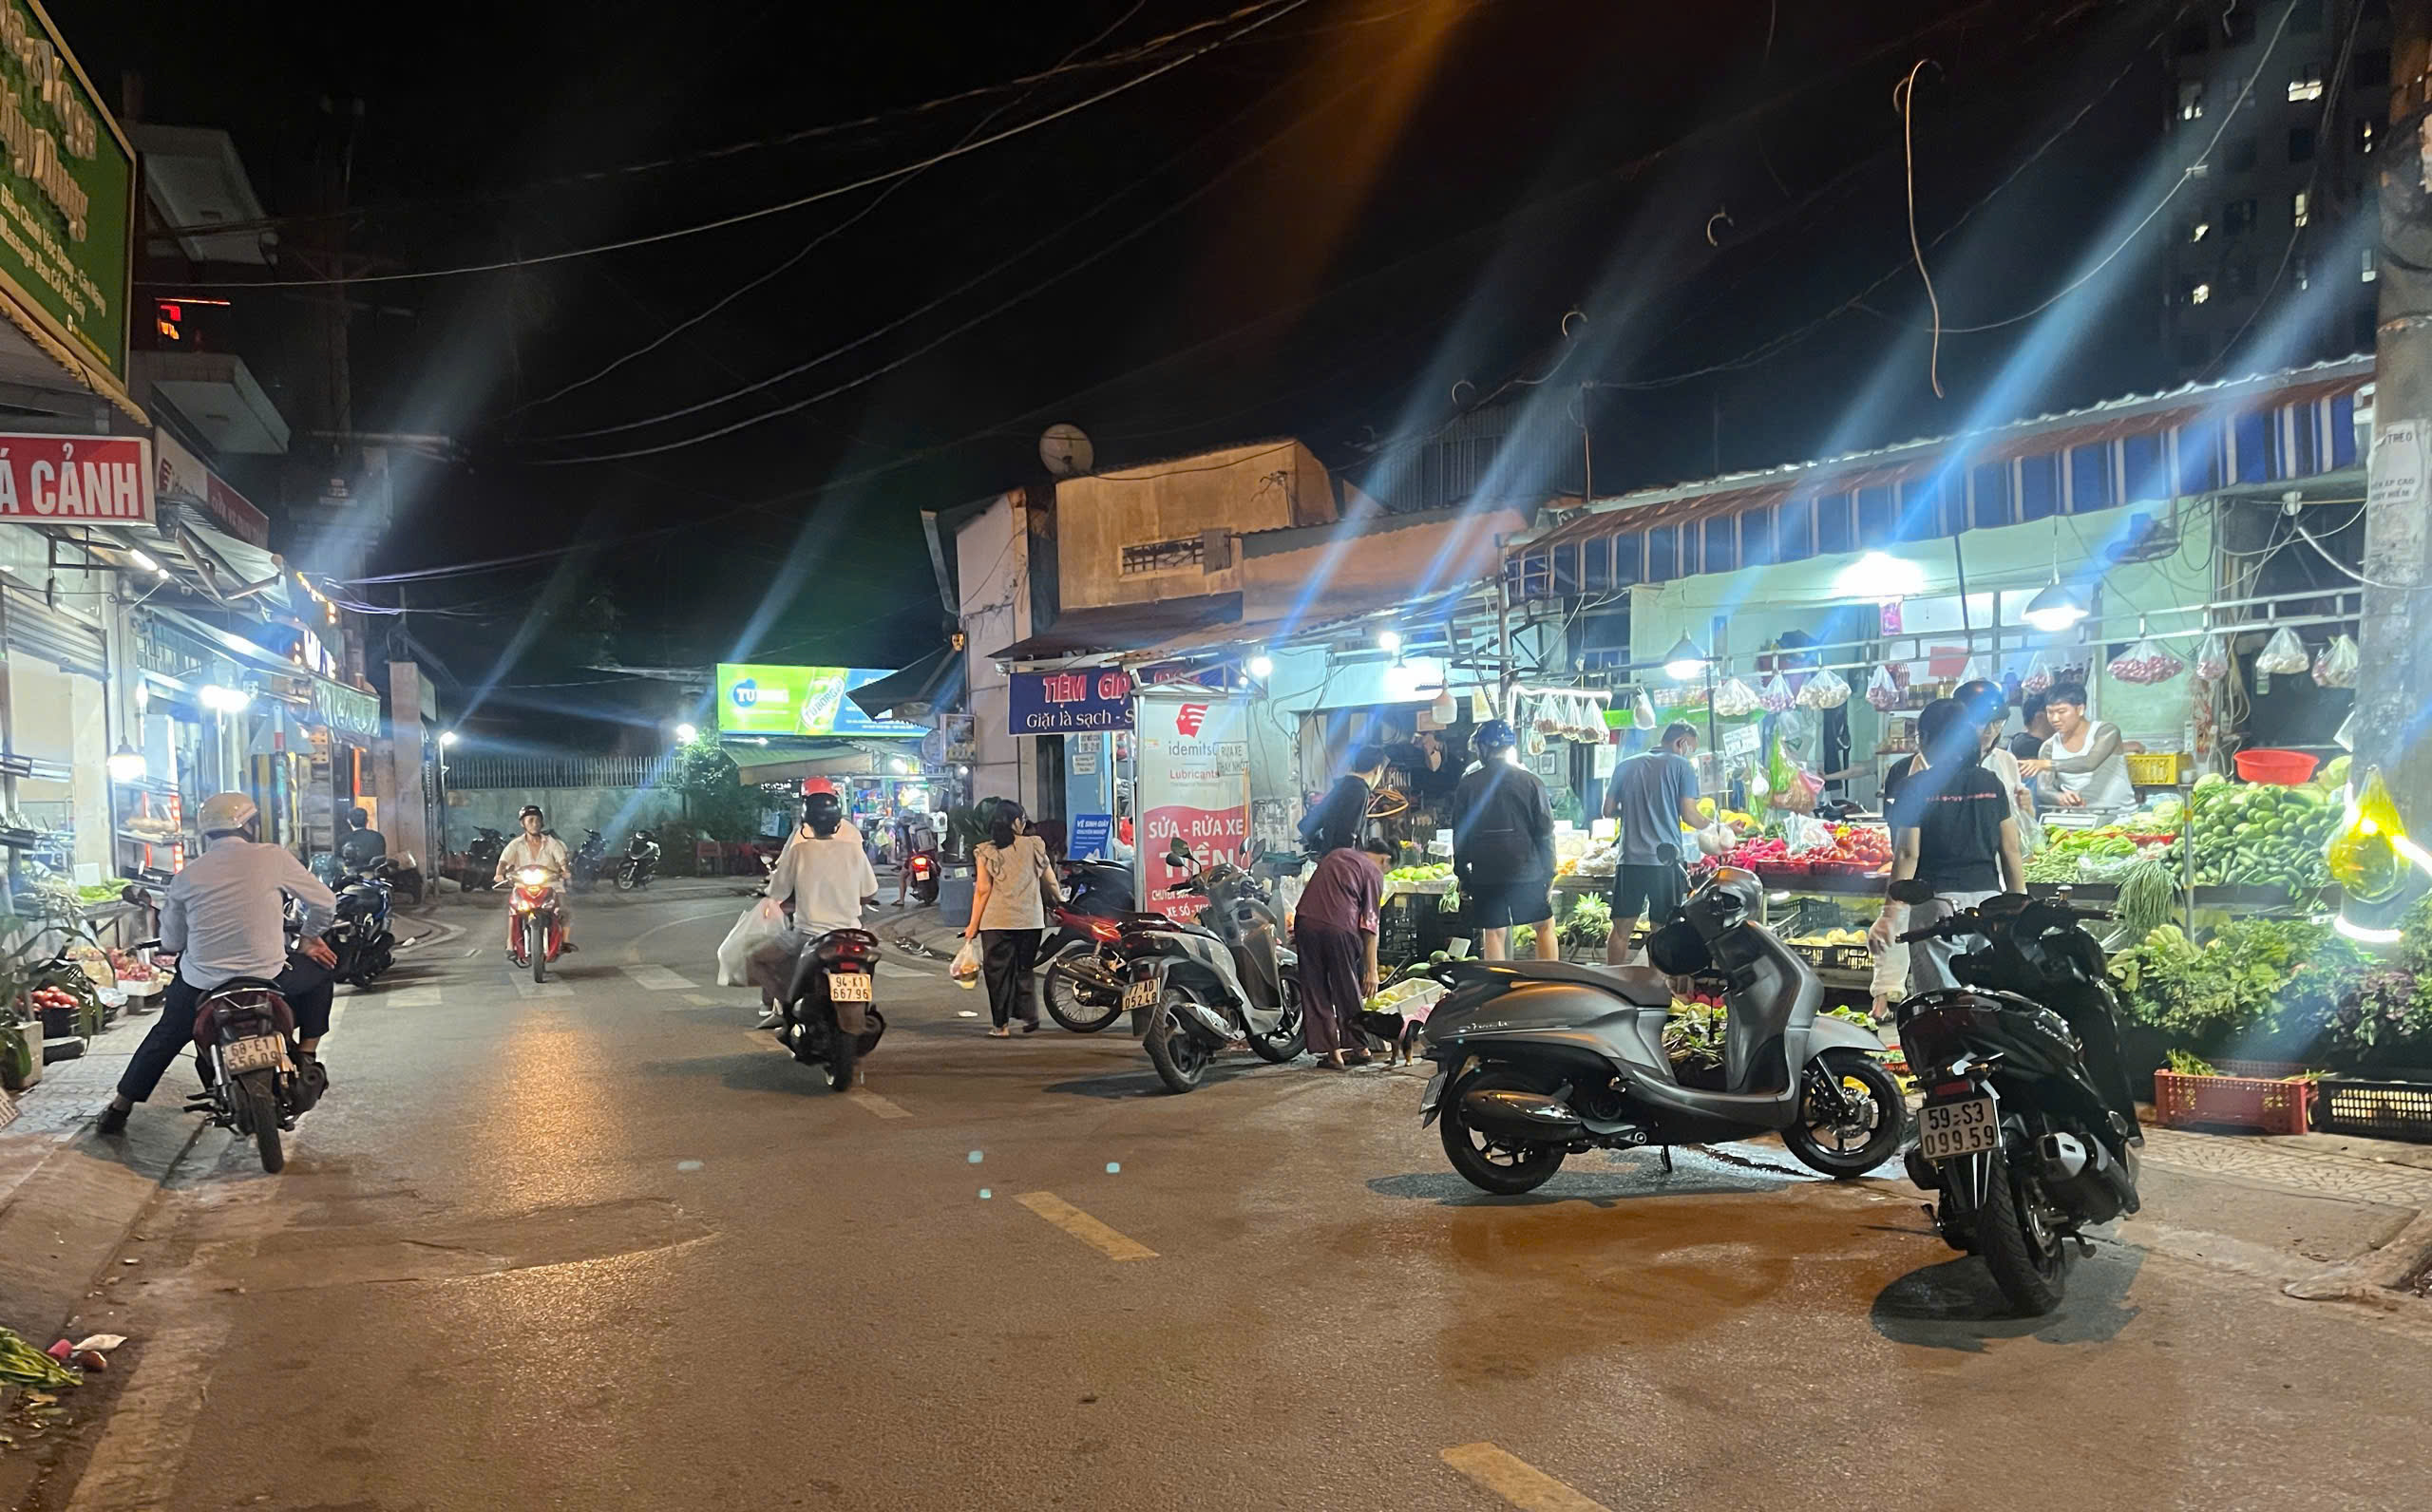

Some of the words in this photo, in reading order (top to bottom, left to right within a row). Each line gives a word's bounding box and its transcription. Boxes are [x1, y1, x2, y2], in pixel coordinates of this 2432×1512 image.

[30, 442, 140, 516] CẢNH
[1042, 672, 1088, 709] TIỆM
[1026, 712, 1055, 729] Giặt
[1059, 710, 1073, 727] là
[1075, 709, 1112, 728] sạch
[1148, 816, 1181, 840] SỬA
[1191, 815, 1224, 837] RỬA
[1226, 819, 1244, 836] XE
[1166, 905, 1178, 917] XE
[1928, 1102, 1985, 1130] 59-S3
[1924, 1125, 1995, 1156] 099.59
